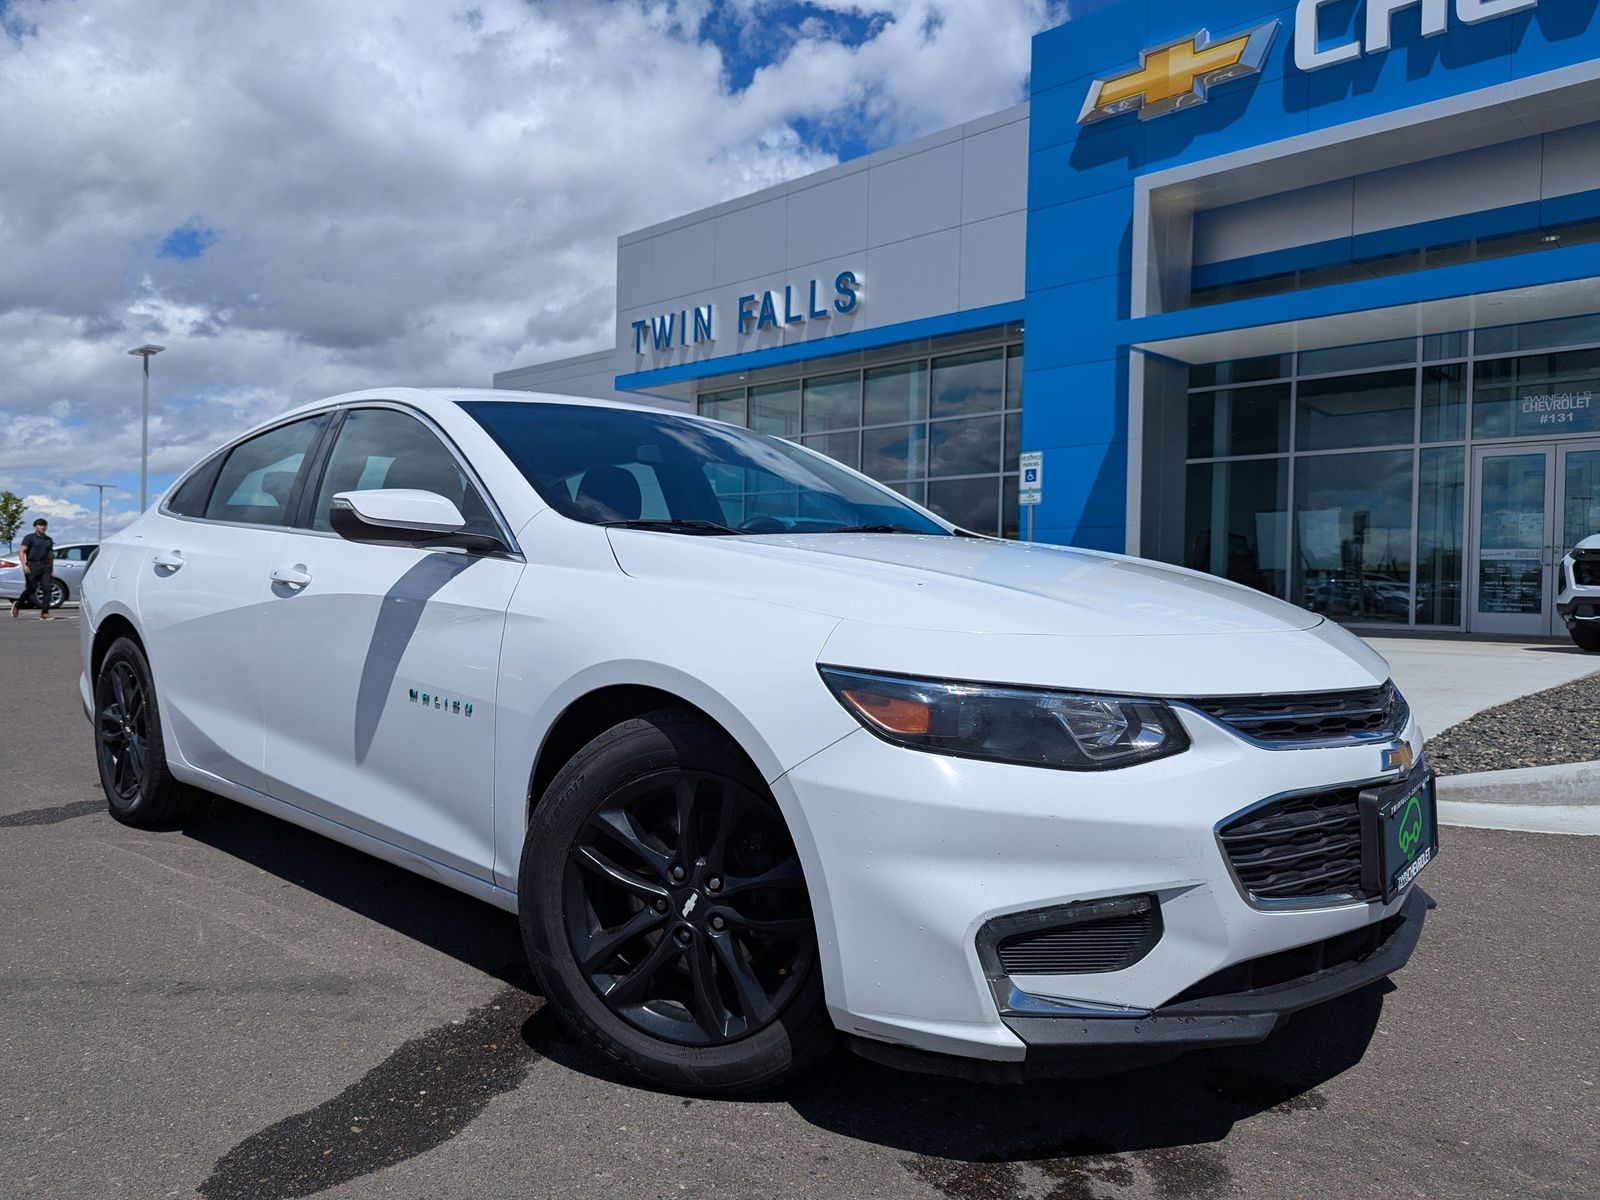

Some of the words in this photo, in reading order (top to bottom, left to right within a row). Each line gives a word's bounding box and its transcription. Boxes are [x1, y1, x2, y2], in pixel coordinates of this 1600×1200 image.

[632, 304, 713, 354] TWIN
[738, 271, 858, 334] FALLS
[1522, 397, 1592, 413] CHEVROLET
[1540, 412, 1574, 425] #131
[409, 688, 473, 716] MALIBU
